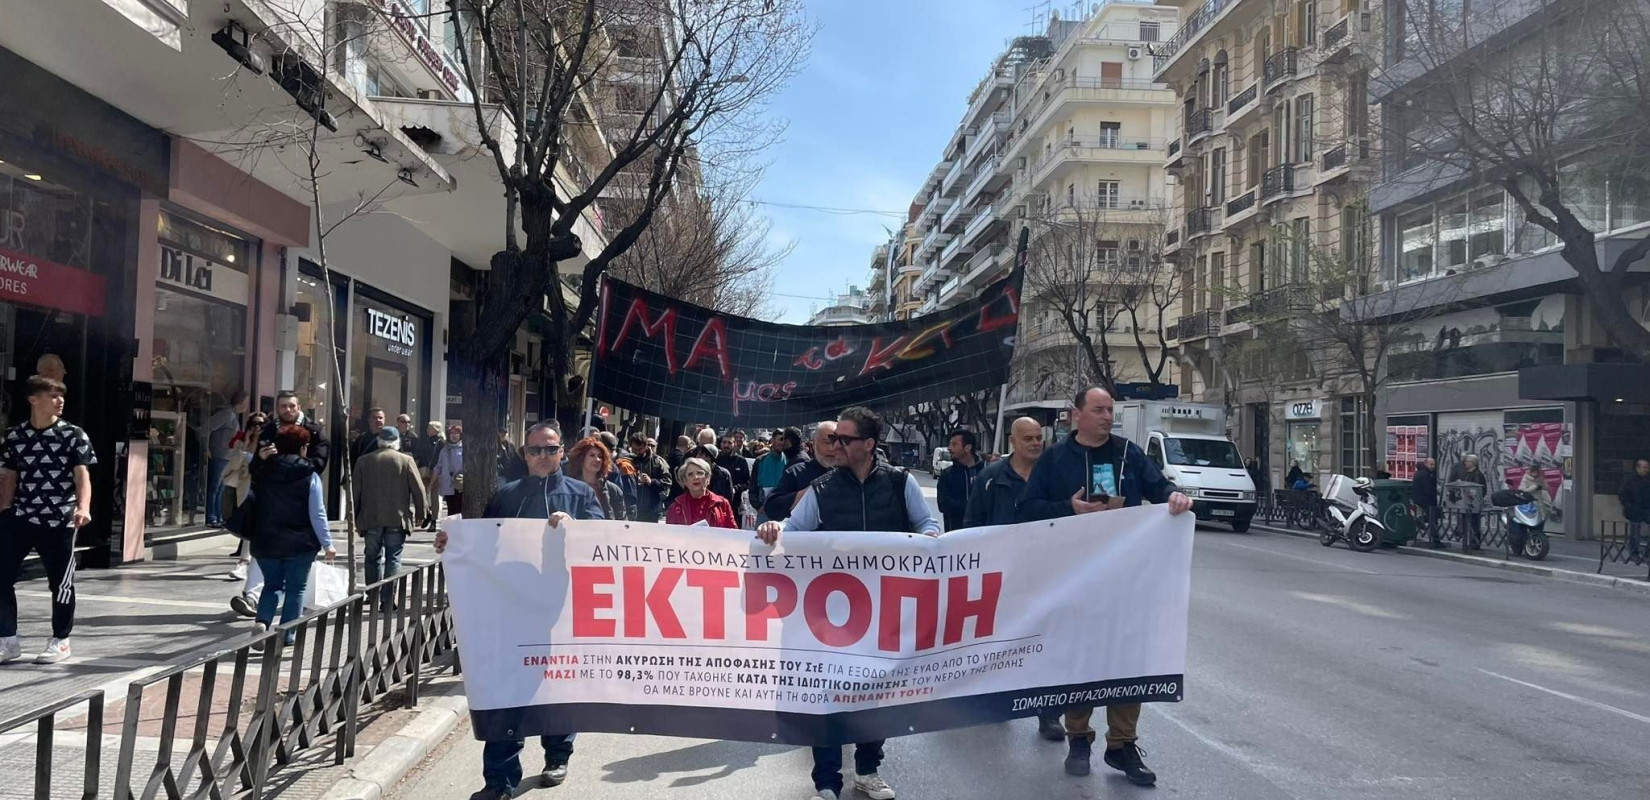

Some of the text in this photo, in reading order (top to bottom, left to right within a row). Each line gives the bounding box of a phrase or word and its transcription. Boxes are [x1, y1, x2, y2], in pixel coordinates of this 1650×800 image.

[0, 255, 38, 279] RWEAR
[592, 544, 981, 574] ΑΝΤΙΣΤΕΚΟΜΑΣΤΕ ΣΤΗ ΔΗΜΟΚΡΑΤΙΚΗ
[571, 566, 1003, 652] ΕΚΤΡΟΠΗ
[524, 643, 1043, 679] ΕΝΑΝΤΙΑ ΣΤΗΝ ΑΚΥΡΩΣΗ ΤΗΣ ΑΠΟΦΑΣΗΣ ΤΟΥ ΣτΕ ΓΙΑ ΕΞΟΔΟ ΤΗΣ ΕΥΑΘ ΑΠΟ ΤΟ ΥΠΕΡΤΑΜΕΙΟ
[544, 658, 1024, 692] ΜΑΖΙ ΜΕ ΤΟ 98,3% ΠΟΥ ΤΑΧΘΗΚΕ ΚΑΤΑ ΤΗΣ ΙΔΙΩΤΙΚΟΠΟΙΗΣΗΣ ΤΟΥ ΝΕΡΟΥ ΤΗΣ ΠΟΛΗΣ
[644, 685, 659, 695] ΘΑ
[663, 685, 685, 696] ΜΑΣ
[689, 686, 731, 698] ΒΡΟΥΝΕ
[735, 688, 752, 699] ΚΑΙ
[755, 689, 783, 701] ΑΥΤΗ
[787, 691, 799, 702] ΤΗ
[801, 692, 830, 704] ΦΟΡΑ
[833, 692, 896, 703] ΑΠΕΝΑΝΤΙ
[1012, 682, 1177, 711] ΣΩΜΑΤΕΙΟ ΕΡΓΑΖΟΜΕΝΩΝ ΕΥΑΘ
